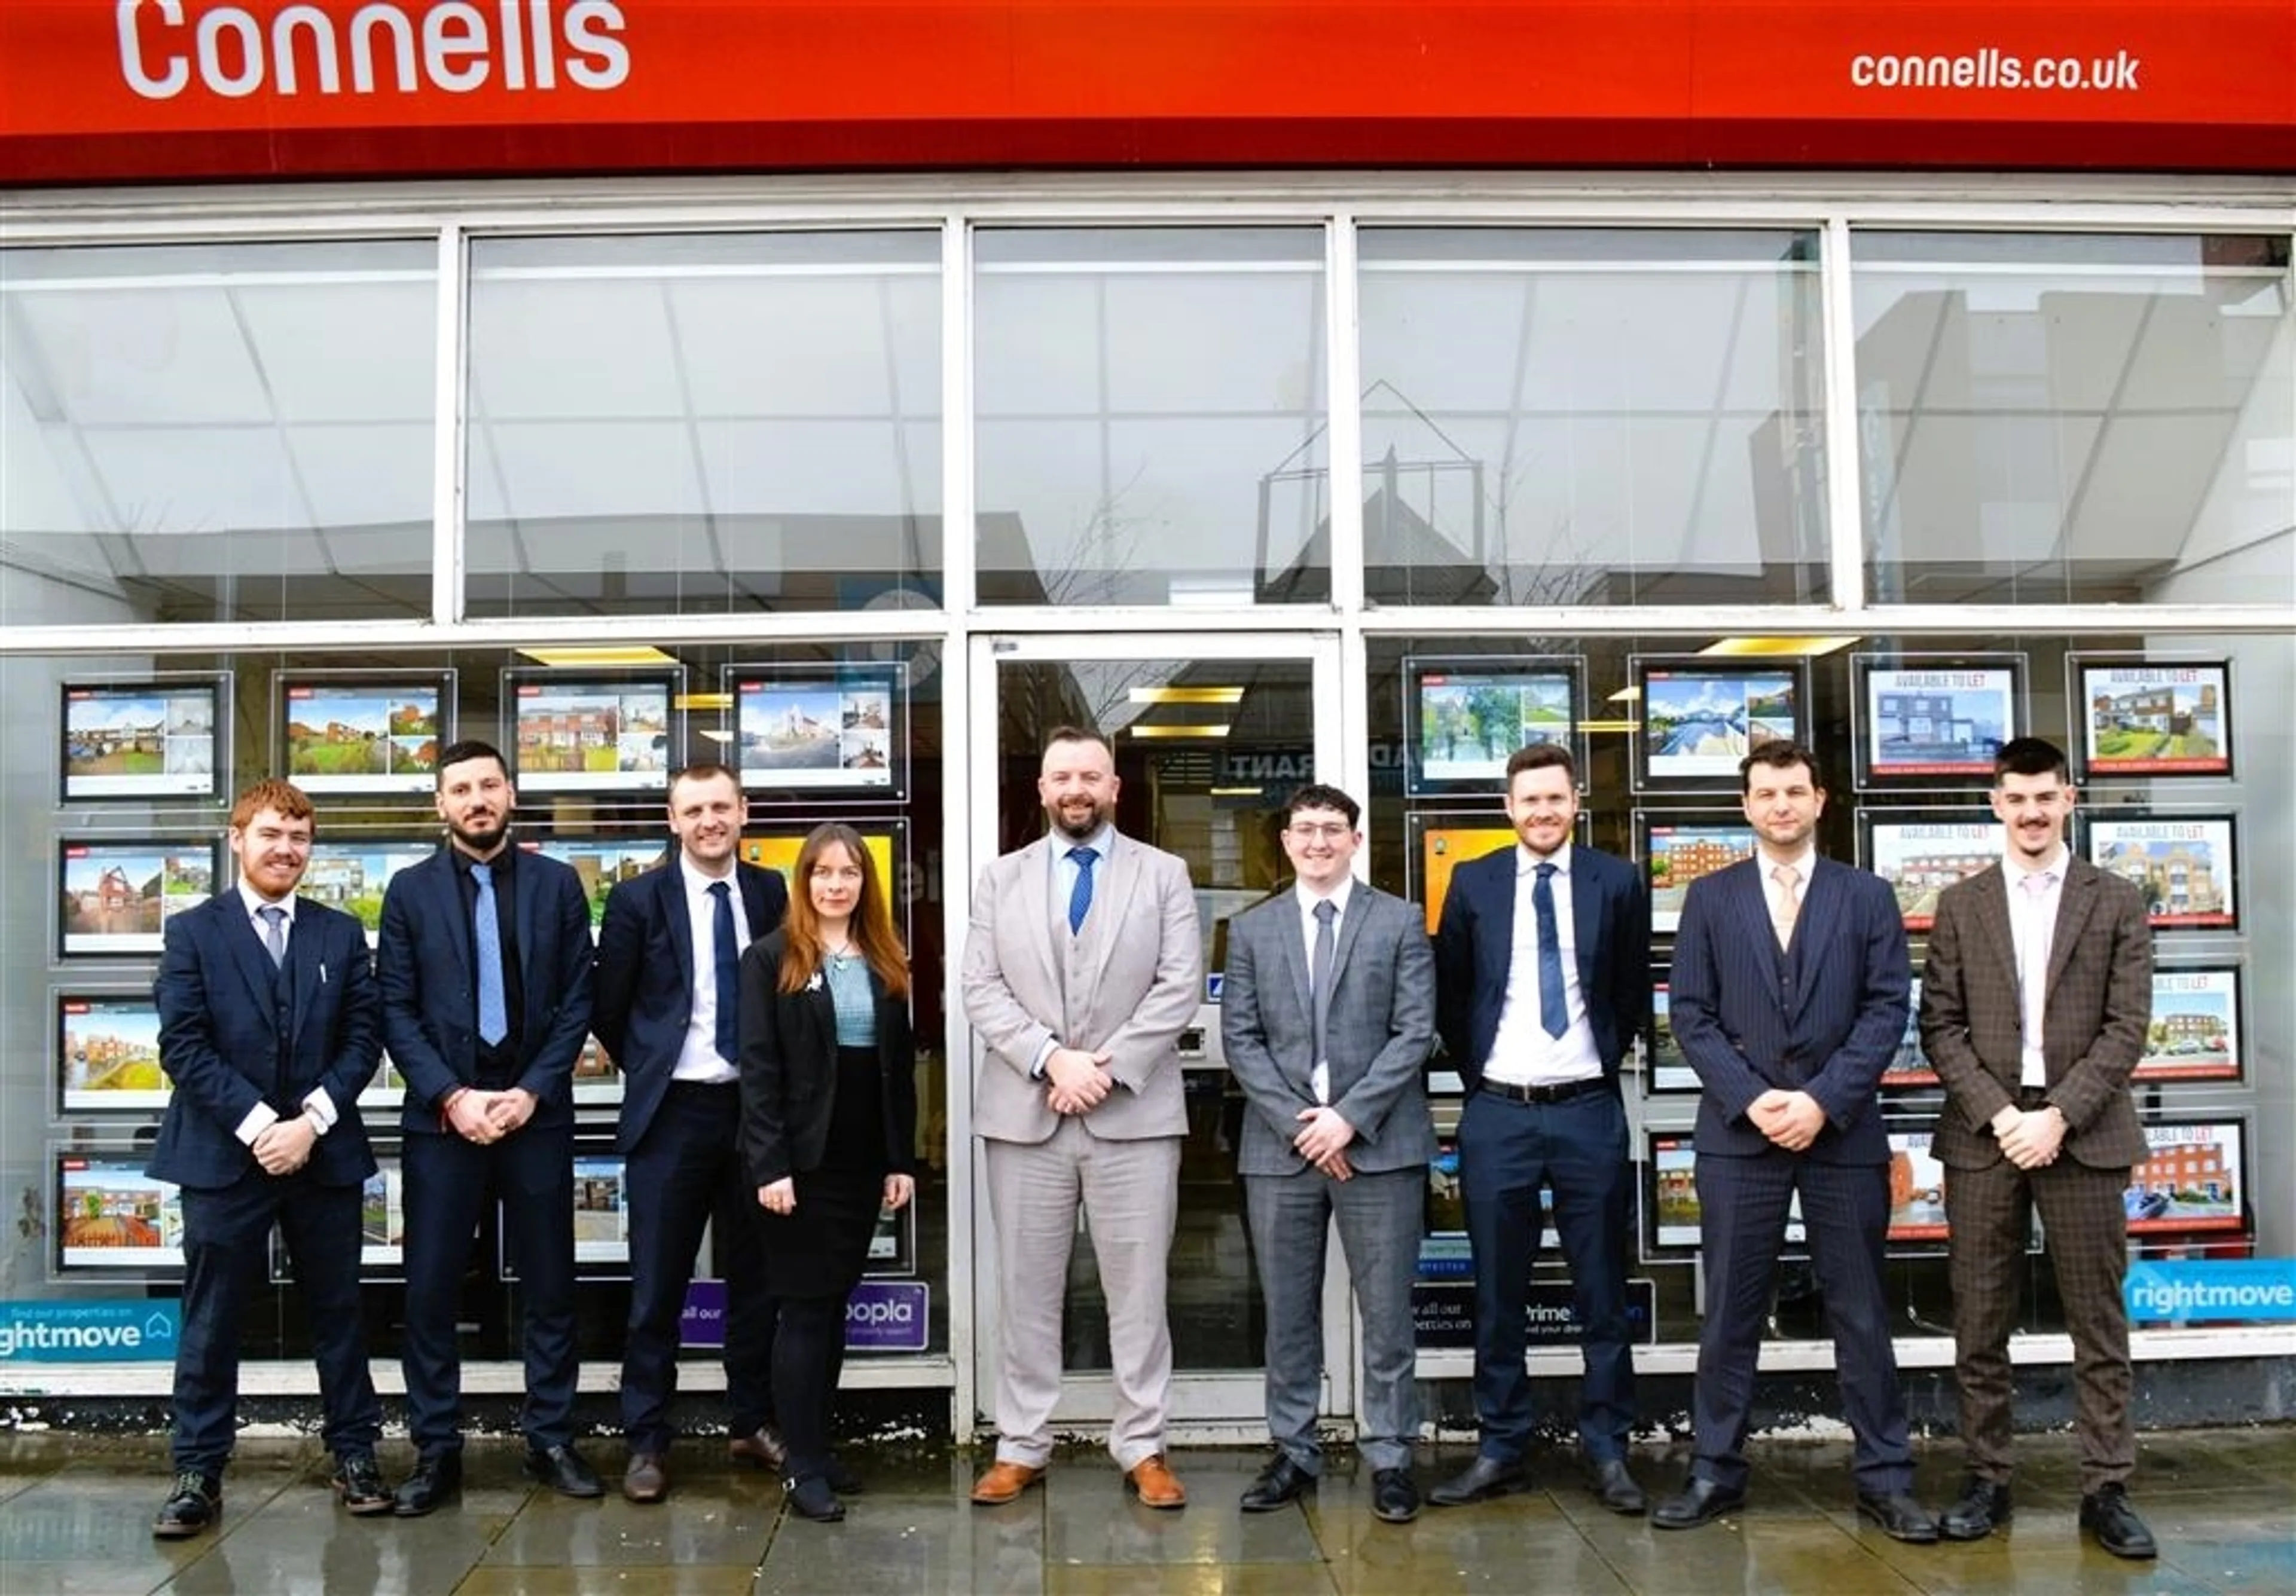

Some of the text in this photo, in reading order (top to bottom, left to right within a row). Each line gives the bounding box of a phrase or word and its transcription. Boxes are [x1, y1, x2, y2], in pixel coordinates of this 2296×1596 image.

[117, 0, 630, 99] Connells
[1852, 49, 2139, 89] connells.co.uk
[1967, 674, 1986, 687] LET
[1971, 825, 1989, 839] LET
[2186, 825, 2205, 839] LET
[845, 1298, 912, 1326] opla
[2132, 1279, 2293, 1314] rightmove
[0, 1320, 141, 1356] ghtmove
